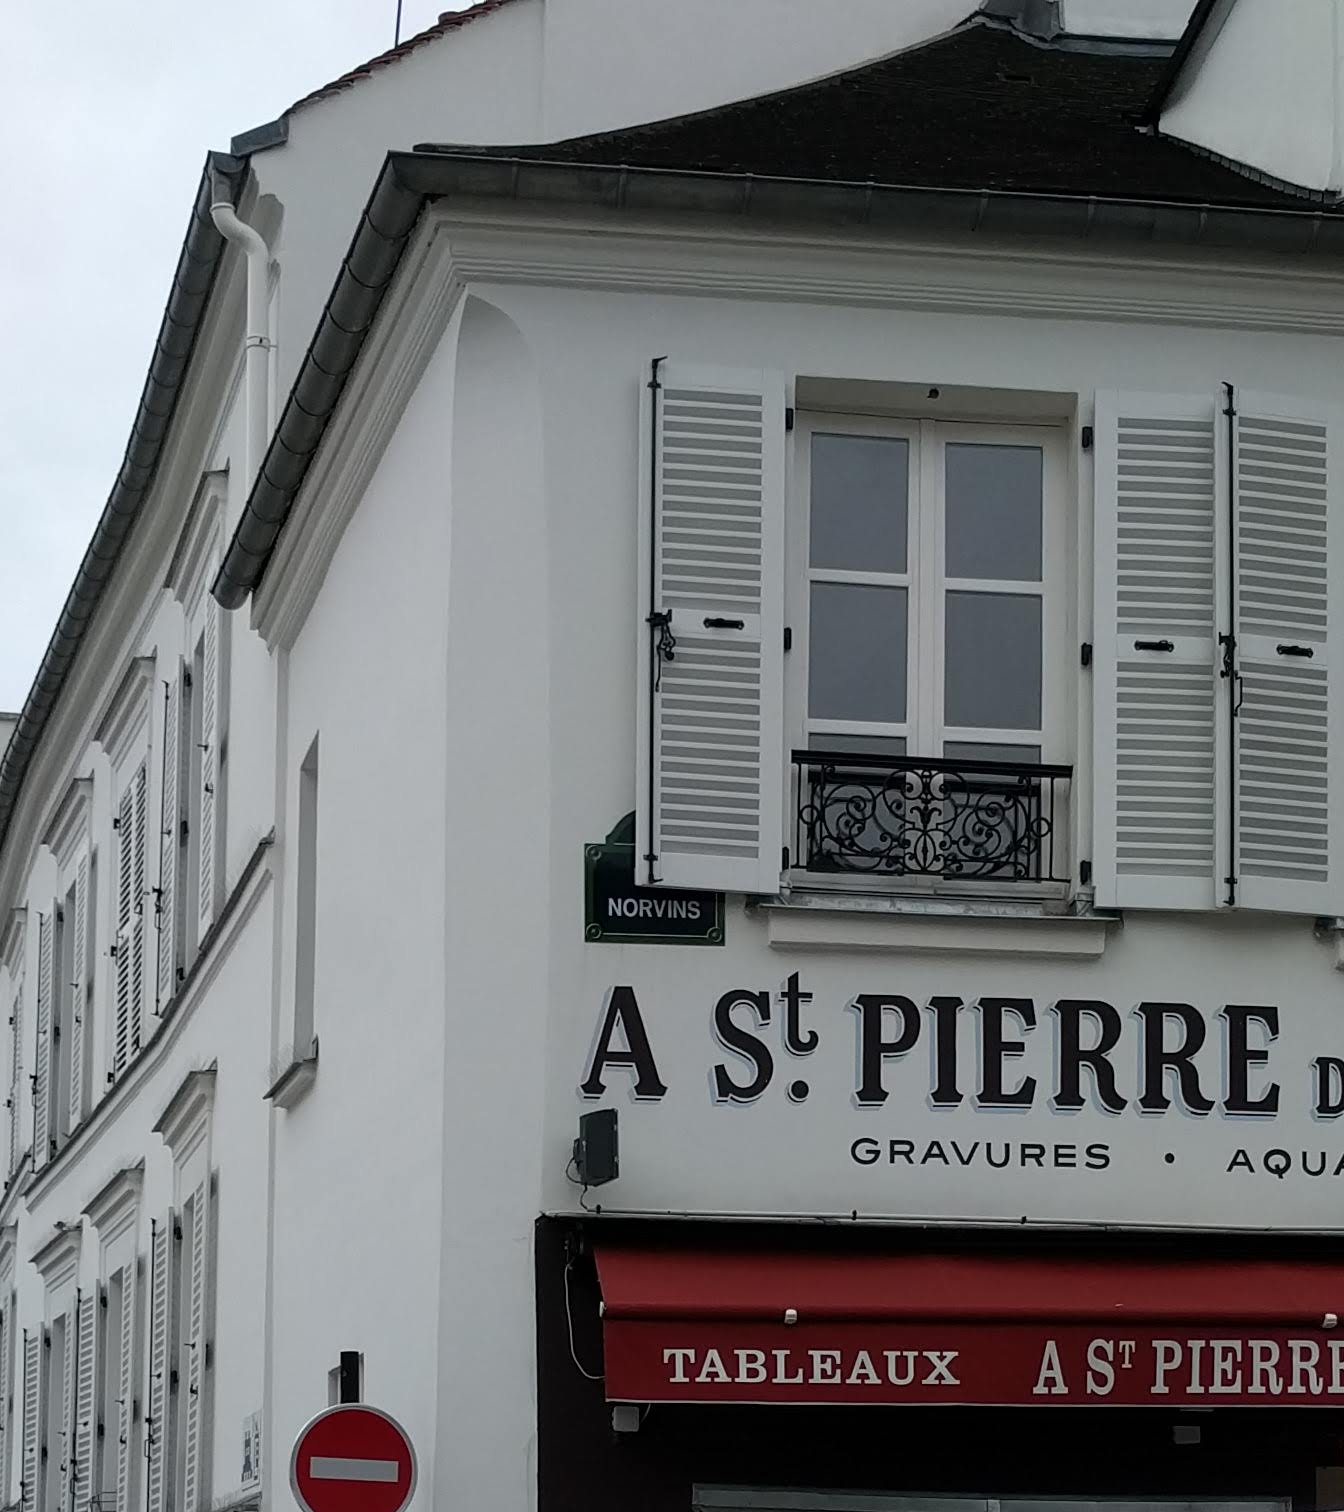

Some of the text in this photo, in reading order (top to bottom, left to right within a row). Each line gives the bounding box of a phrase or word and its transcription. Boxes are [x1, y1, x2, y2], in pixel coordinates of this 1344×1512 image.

[607, 897, 702, 920] NORVINS
[578, 985, 668, 1101] A
[851, 992, 1282, 1118] PIERRE
[850, 1137, 1112, 1170] GRAVURES
[662, 1348, 962, 1386] TABLEAUX
[1032, 1339, 1069, 1395] A
